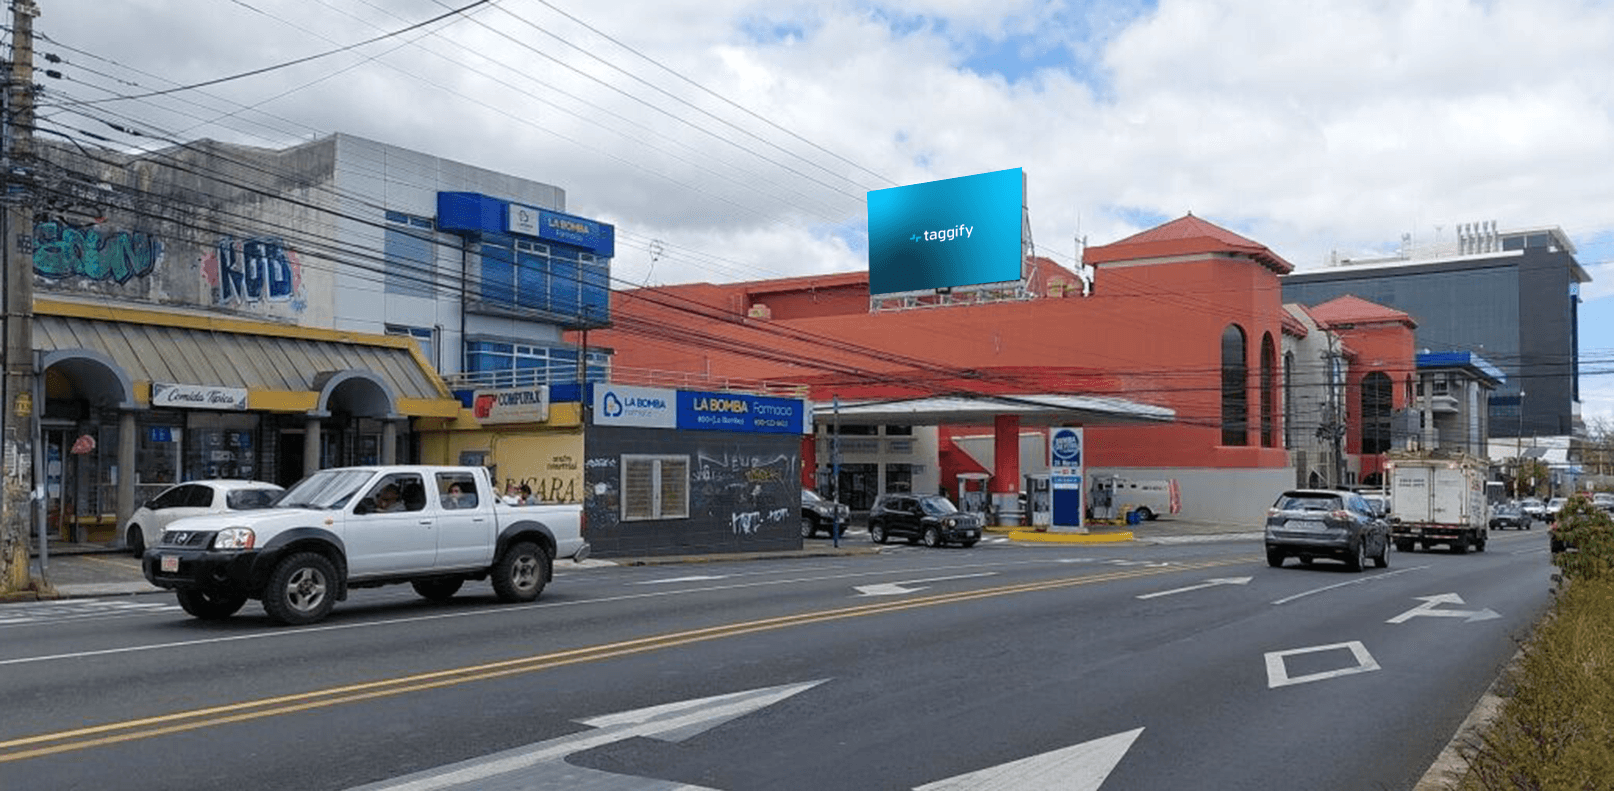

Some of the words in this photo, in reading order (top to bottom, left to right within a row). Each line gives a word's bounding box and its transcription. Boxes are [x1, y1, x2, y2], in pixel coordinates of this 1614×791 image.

[924, 224, 973, 242] taggify
[168, 388, 204, 402] Comida
[625, 397, 635, 407] LA
[637, 398, 666, 409] BOMBA
[693, 398, 708, 411] LA
[710, 398, 748, 413] BOMBA
[753, 402, 793, 416] Farmacia
